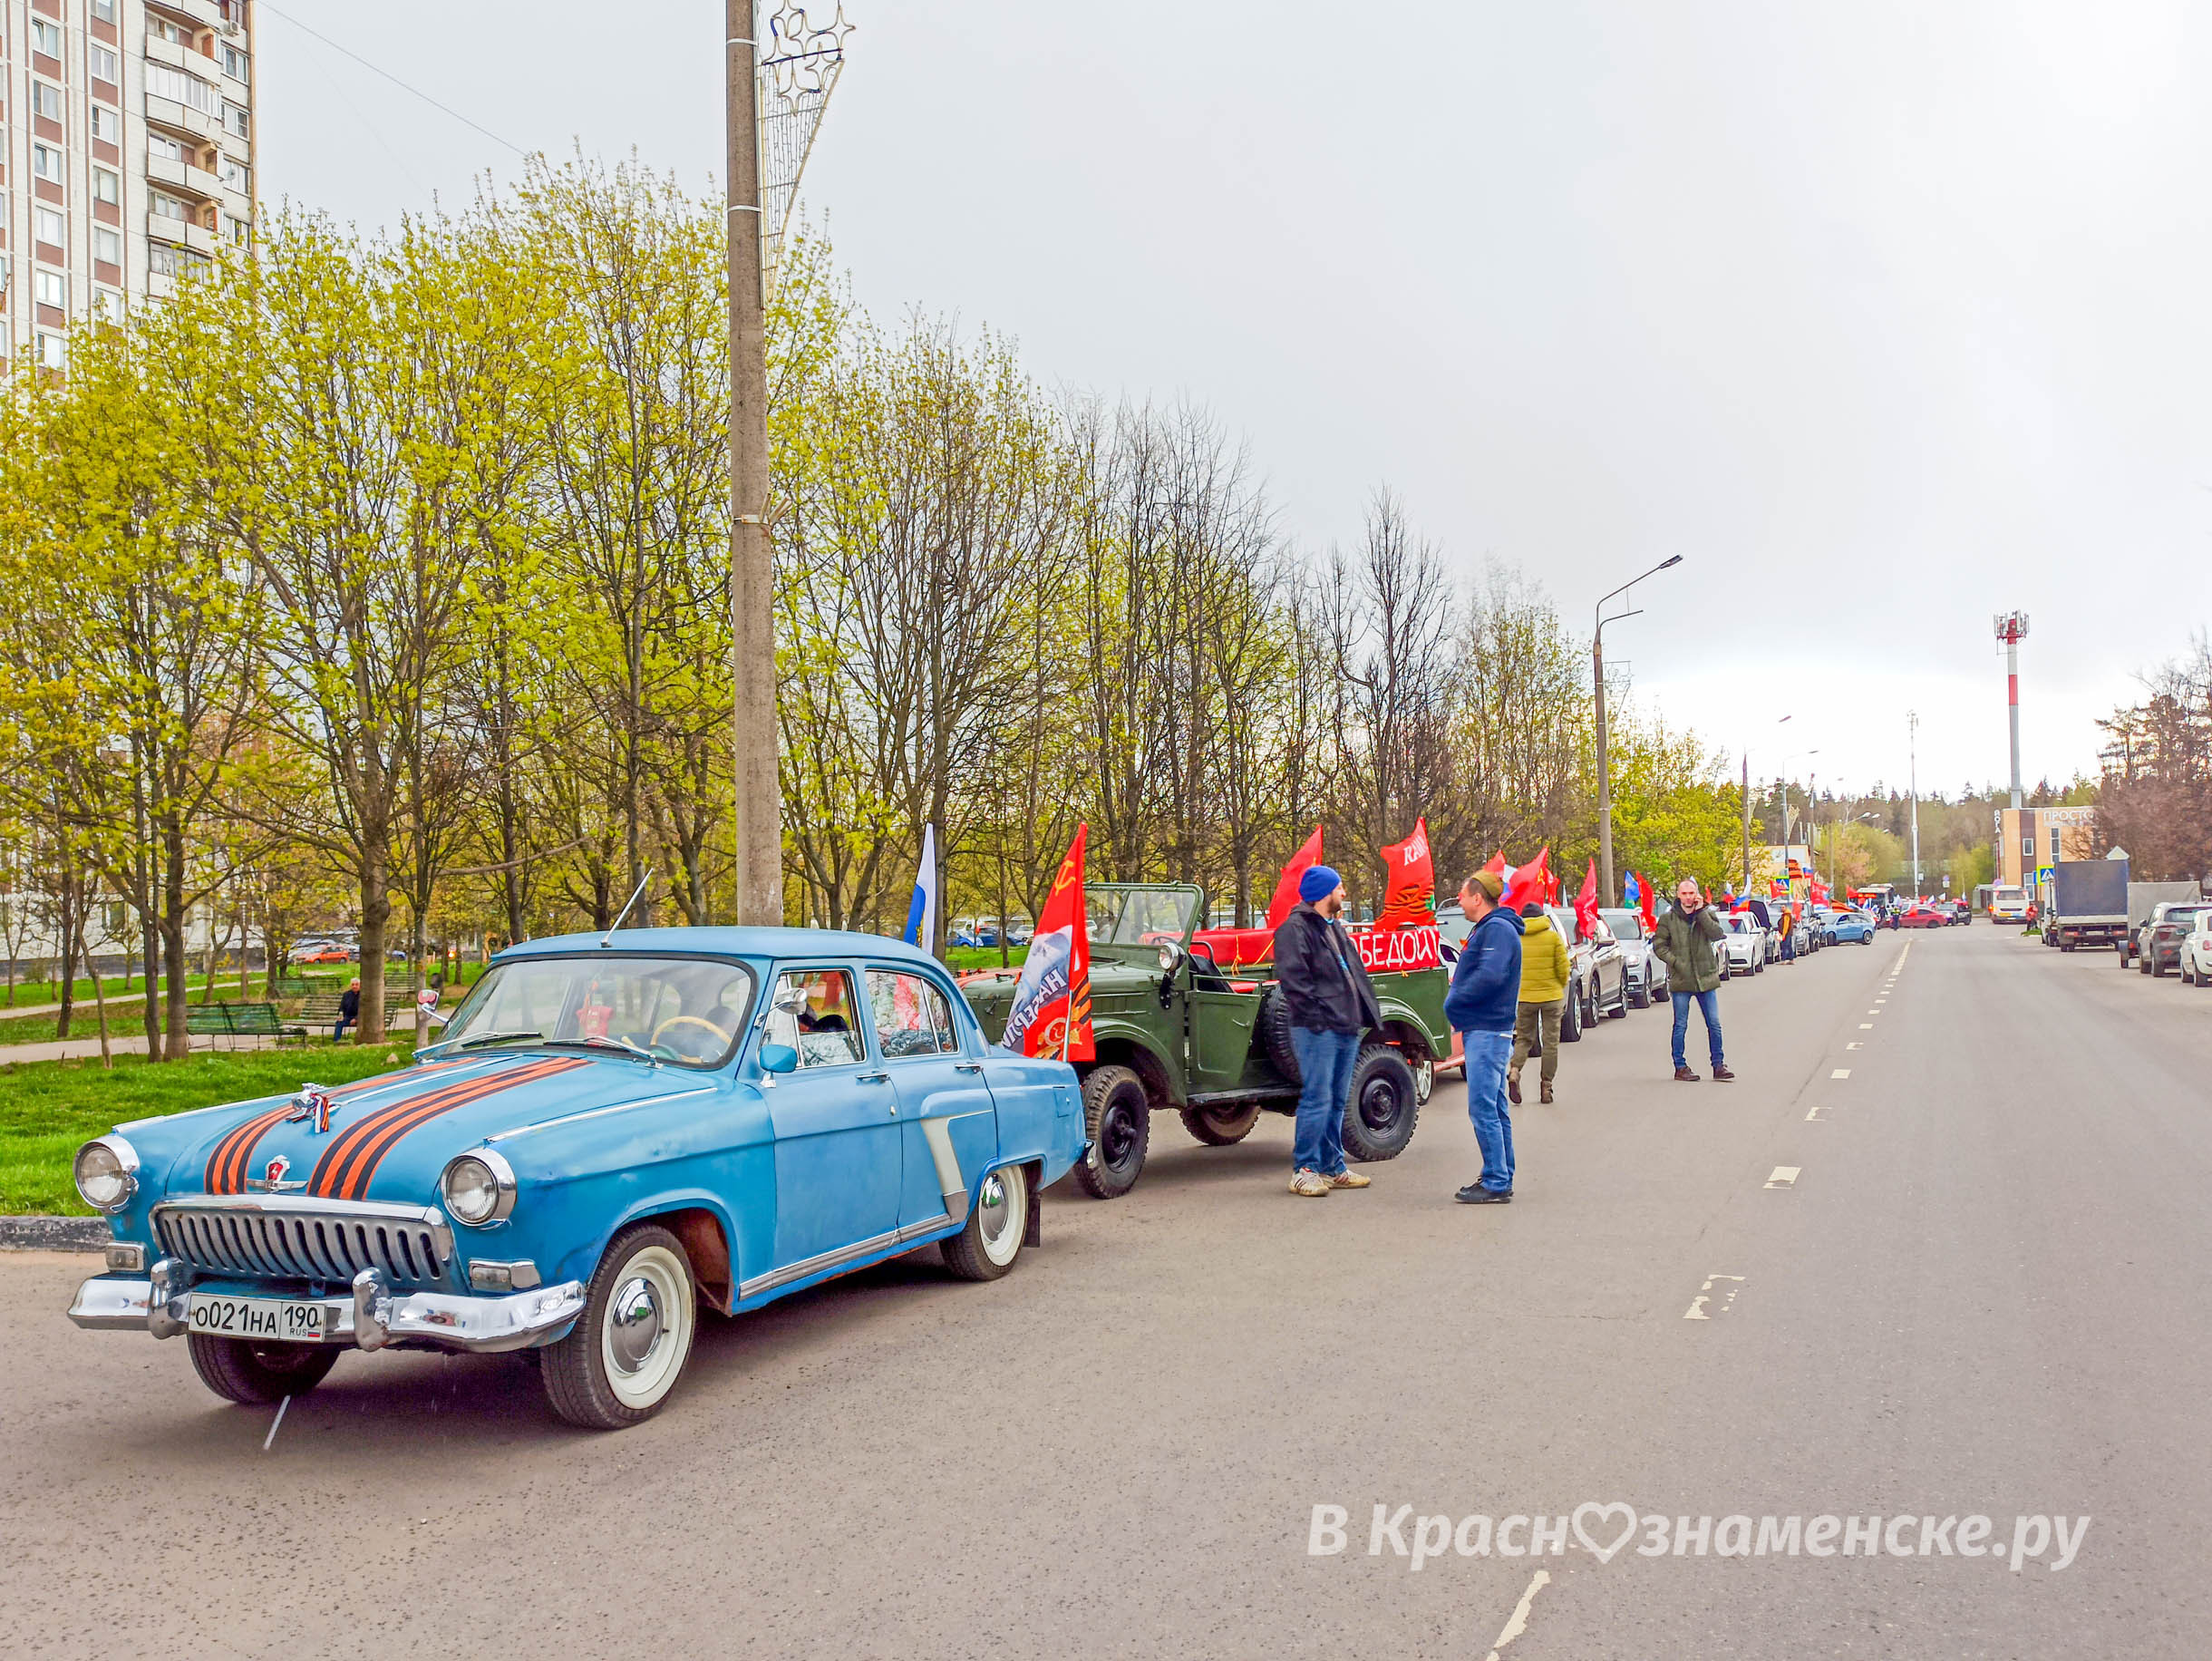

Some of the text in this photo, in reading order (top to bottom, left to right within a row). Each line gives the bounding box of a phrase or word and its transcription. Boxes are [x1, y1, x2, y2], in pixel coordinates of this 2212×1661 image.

[195, 1301, 318, 1334] О021НА 190
[289, 1327, 307, 1336] RUS
